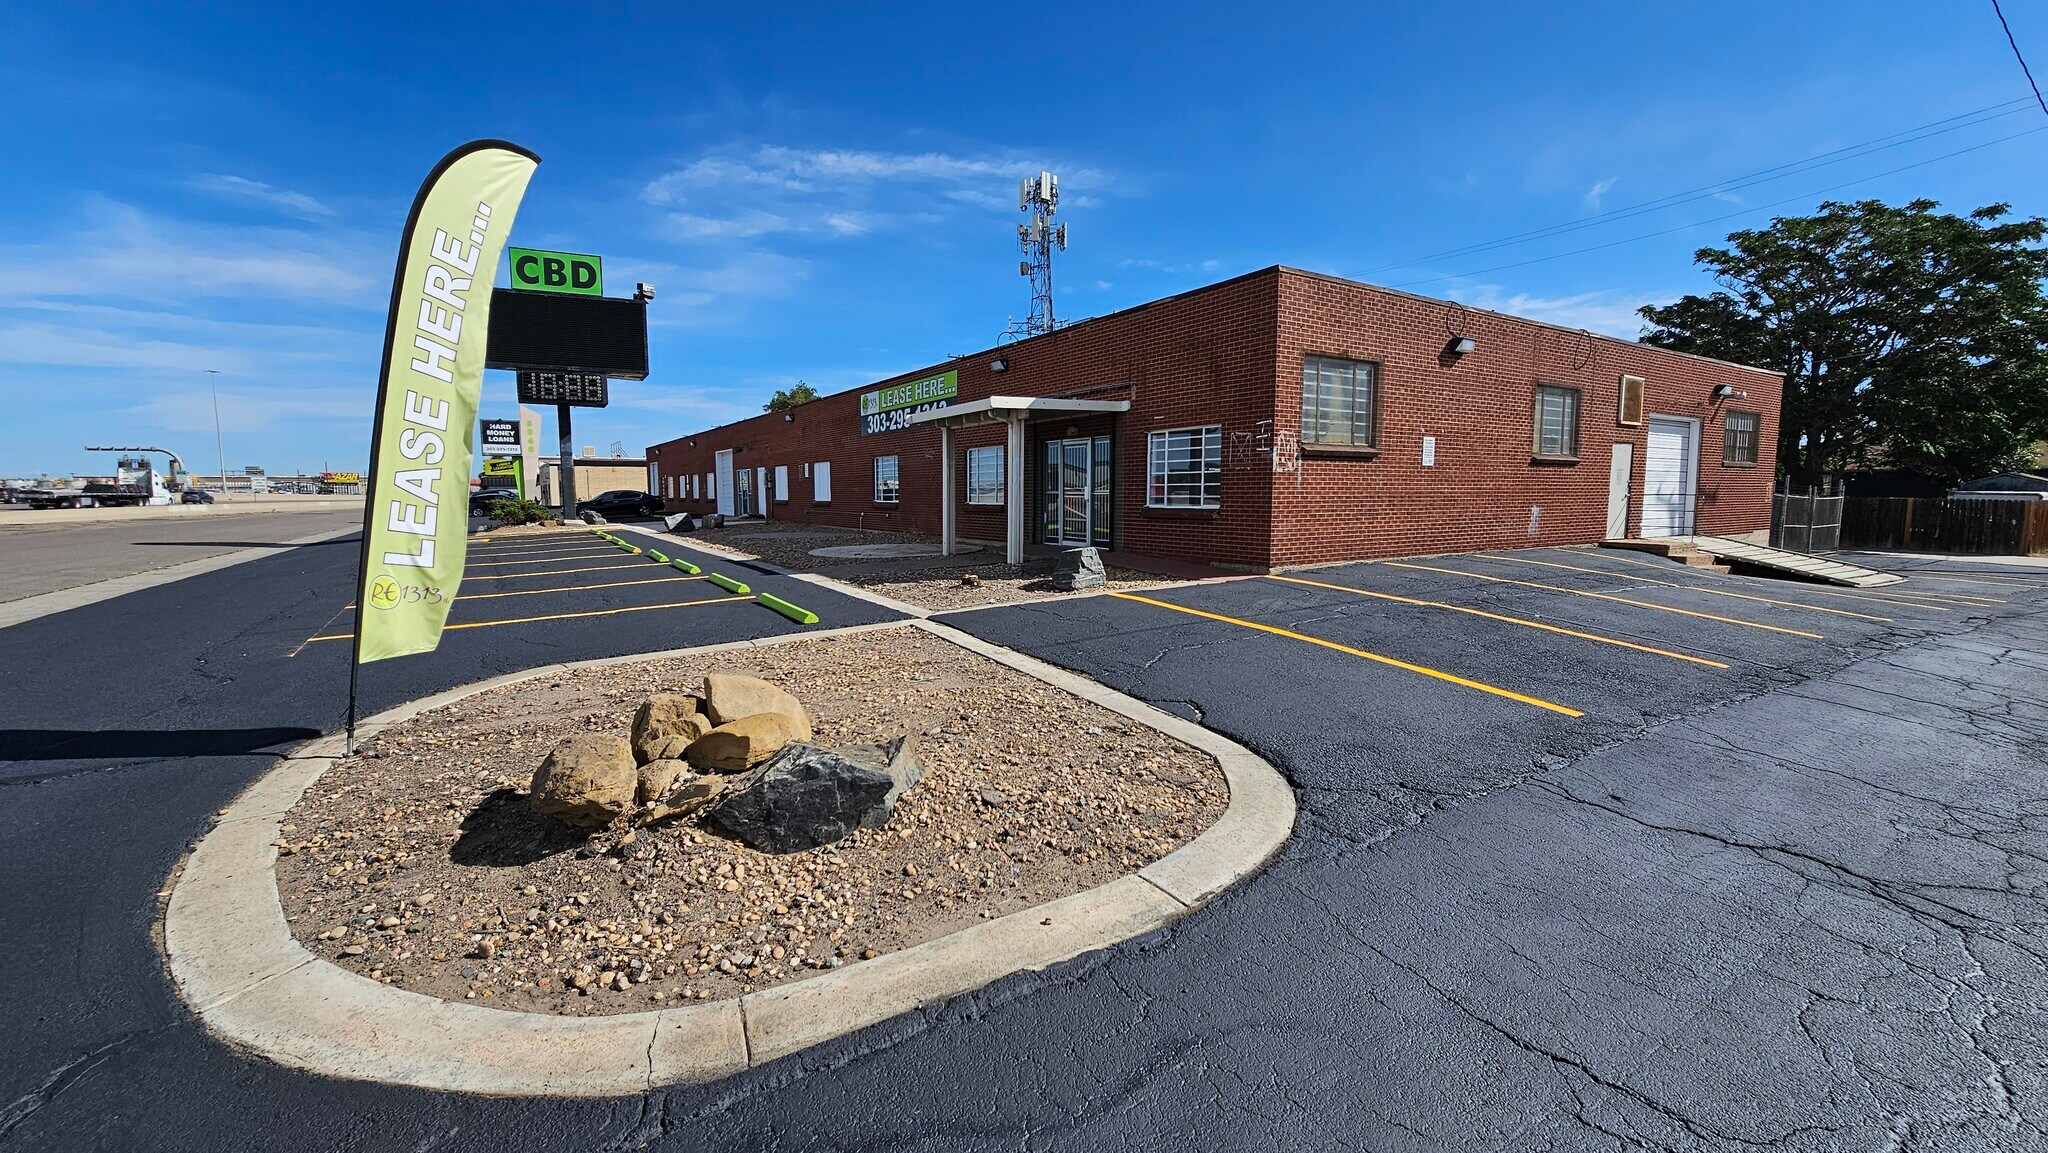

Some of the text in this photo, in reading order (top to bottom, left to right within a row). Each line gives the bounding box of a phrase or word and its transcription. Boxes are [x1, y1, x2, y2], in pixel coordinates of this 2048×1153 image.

[515, 255, 597, 289] CBD
[383, 201, 492, 568] LEASE HERE...
[881, 385, 912, 408] LEASE
[915, 377, 956, 400] HERE...
[402, 585, 443, 605] 1313
